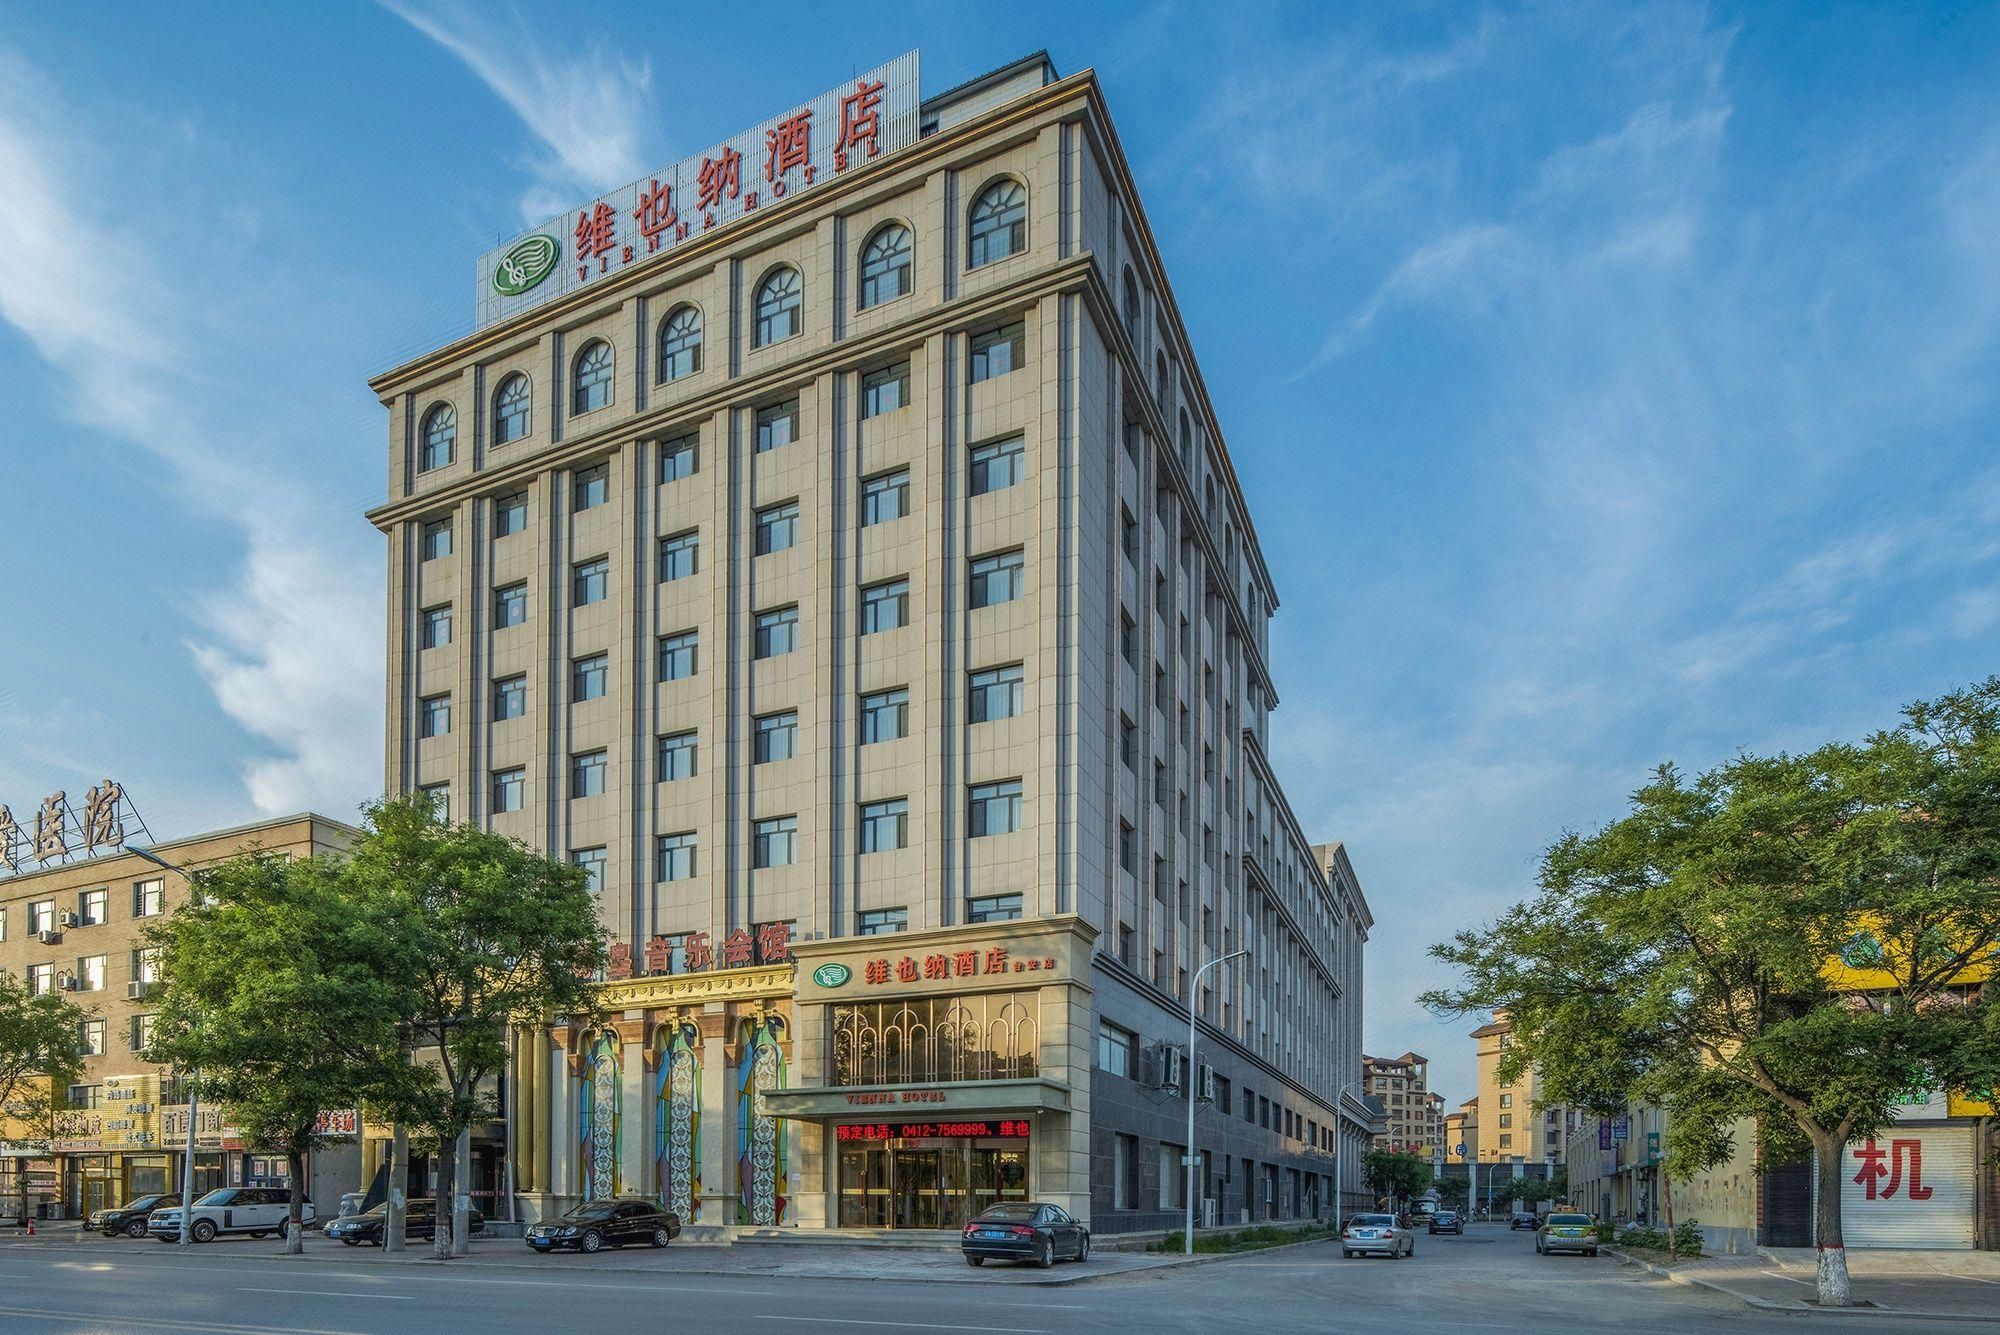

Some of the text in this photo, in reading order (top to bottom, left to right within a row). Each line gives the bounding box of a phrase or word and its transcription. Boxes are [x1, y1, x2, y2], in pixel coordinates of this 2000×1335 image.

[575, 80, 884, 261] 维也纳酒店
[577, 136, 880, 281] VIENNA HOTEL
[865, 946, 1009, 985] 维也纳酒店
[845, 1090, 946, 1105] VIENNA HOTEL
[1853, 1138, 1934, 1201] 机
